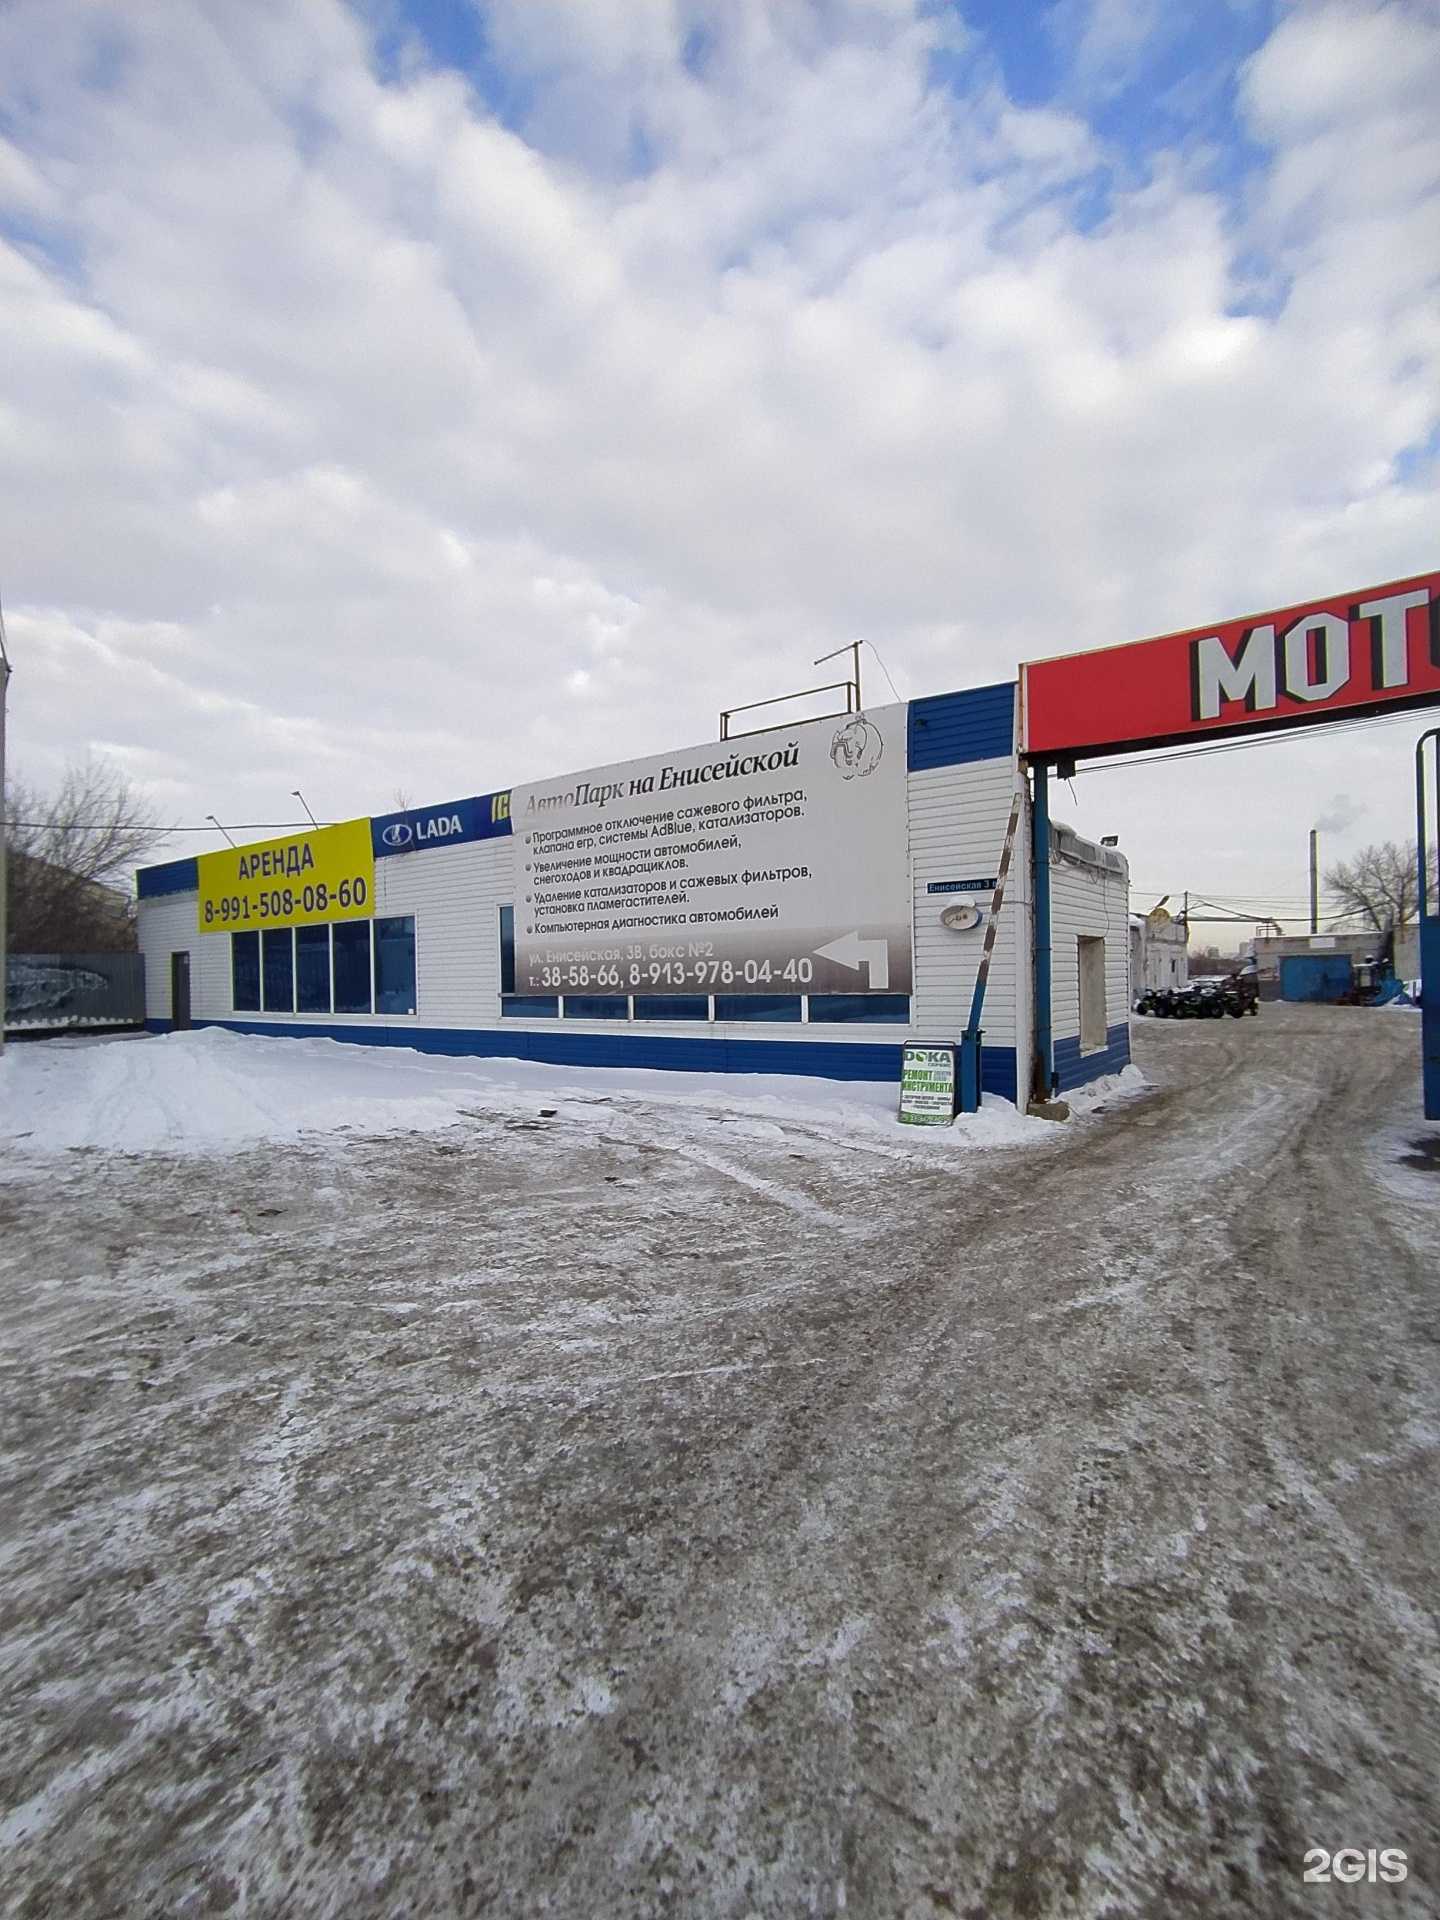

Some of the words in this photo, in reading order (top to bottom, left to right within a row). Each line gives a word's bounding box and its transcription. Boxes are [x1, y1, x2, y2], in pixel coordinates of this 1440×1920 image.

[1190, 588, 1440, 720] МОТ
[525, 782, 624, 816] АвтоПарк
[629, 776, 655, 796] на
[659, 741, 799, 791] Енисейской
[416, 815, 463, 840] LADA
[532, 823, 603, 843] Программное
[605, 809, 674, 831] отключение
[677, 799, 740, 820] сажевого
[743, 789, 808, 809] фильтра,
[533, 839, 574, 855] клапана
[599, 828, 648, 845] системы
[651, 821, 696, 838] AdBlue,
[698, 805, 805, 831] катализаторов.
[238, 843, 315, 881] АРЕНДА
[533, 871, 592, 886] снегоходов
[594, 869, 601, 878] и
[602, 858, 689, 877] квадрациклов.
[534, 857, 592, 873] Увеличение
[594, 848, 651, 865] мощности
[653, 834, 742, 857] автомобилей,
[204, 877, 367, 924] 8-991-508-08-60
[534, 890, 582, 905] Удаление
[584, 880, 667, 898] катализаторов
[669, 879, 677, 890] и
[679, 872, 738, 889] сажевых
[741, 866, 812, 886] фильтров,
[534, 903, 585, 918] установка
[587, 891, 690, 911] пламегастителей.
[534, 917, 610, 934] Компьютерная
[611, 913, 687, 930] диагностика
[688, 904, 779, 924] автомобилей
[650, 943, 685, 959] бокс
[688, 942, 714, 958] №2
[541, 964, 624, 988] 38-58-66,
[629, 957, 813, 985] 8-913-978-04-40
